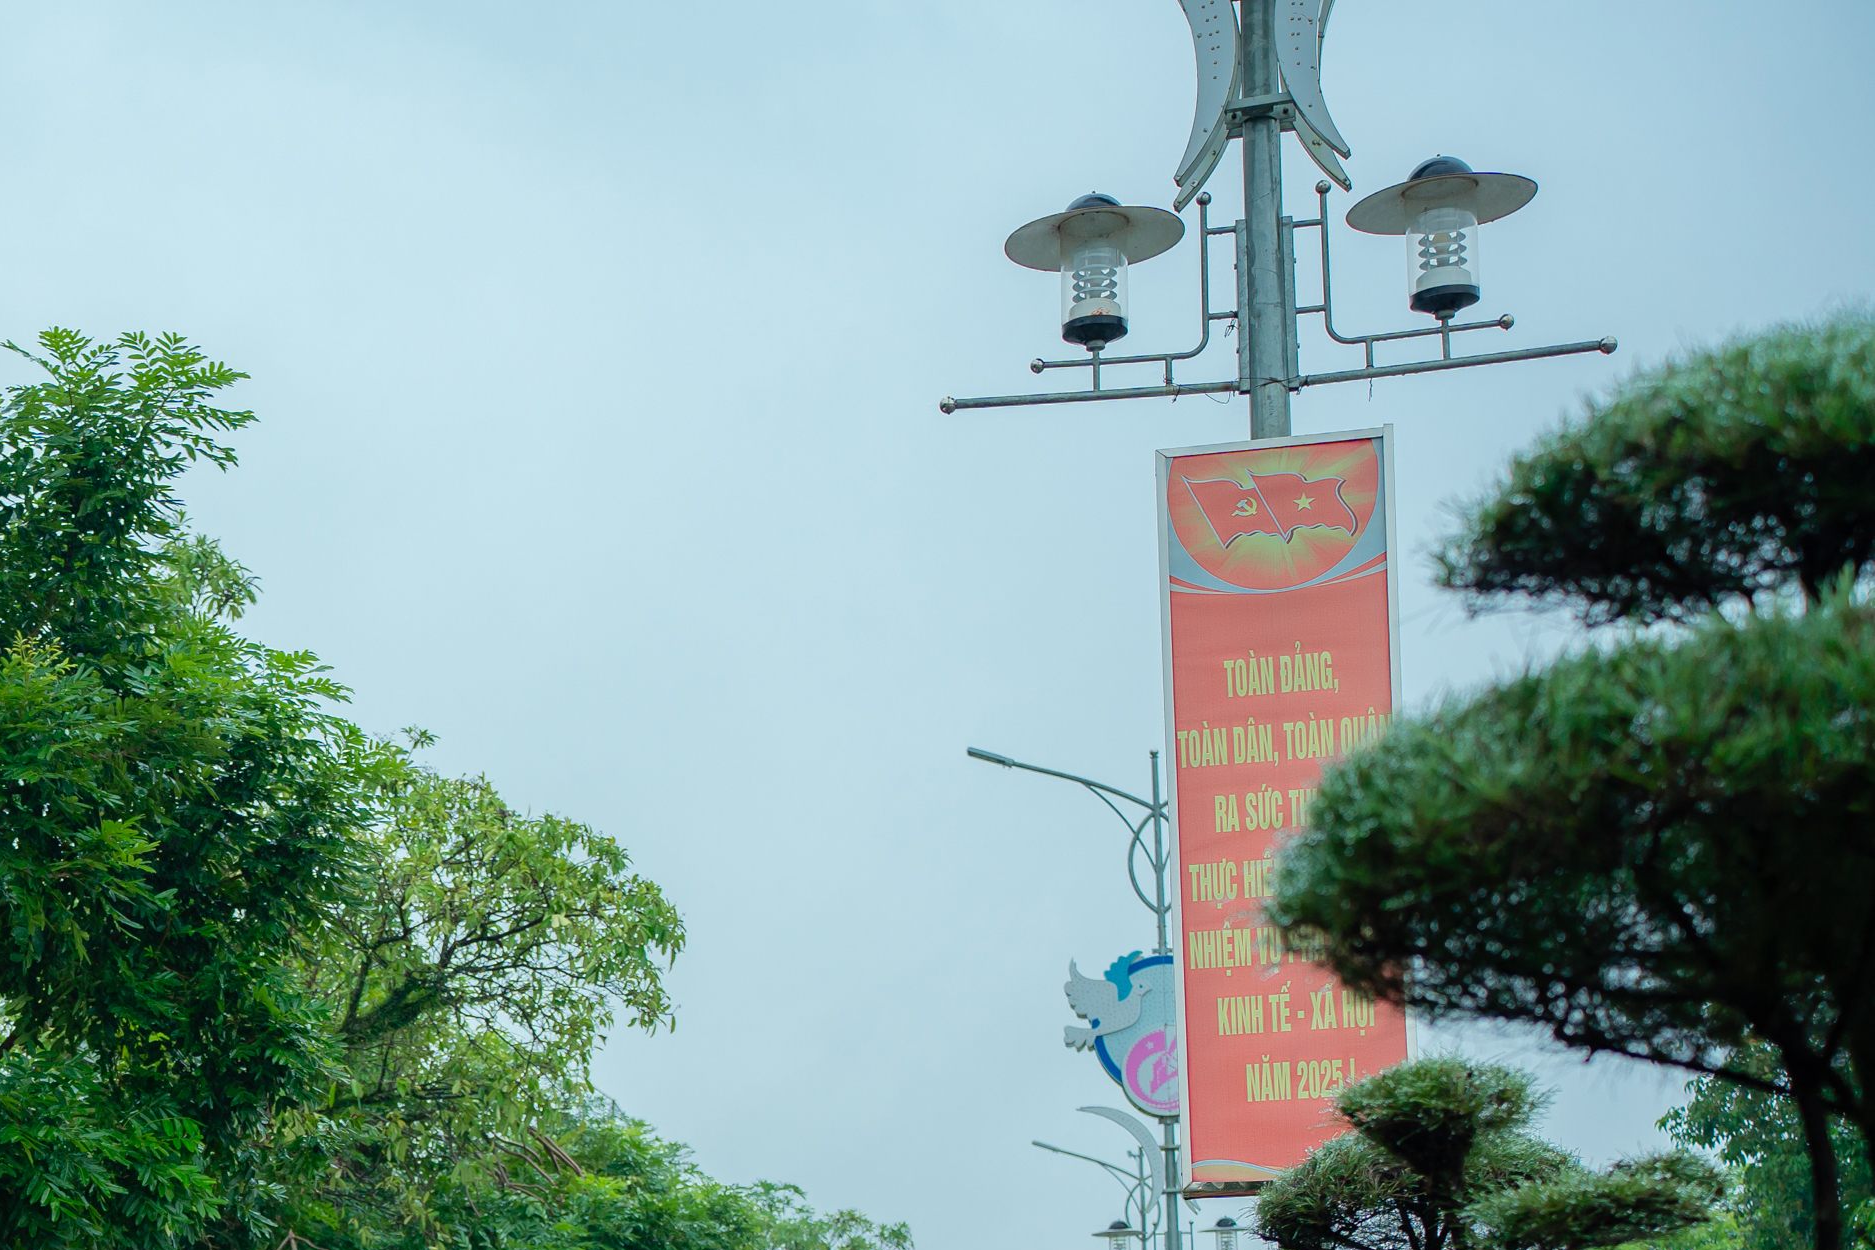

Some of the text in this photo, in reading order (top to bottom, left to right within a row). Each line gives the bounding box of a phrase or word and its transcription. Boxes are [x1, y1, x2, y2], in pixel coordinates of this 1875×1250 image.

[1224, 641, 1339, 698] TOÀN ĐẢNG,
[1177, 721, 1228, 768] TOÀN
[1233, 717, 1279, 767] DÂN,
[1283, 711, 1335, 761] TOÀN
[1214, 794, 1239, 833] RA
[1245, 783, 1283, 831] SỨC
[1189, 858, 1238, 909] THỰC
[1189, 921, 1252, 977] NHIỆM
[1217, 995, 1264, 1036] KINH
[1269, 980, 1291, 1033] TẾ
[1246, 1055, 1291, 1102] NĂM
[1297, 1062, 1343, 1099] 2025
